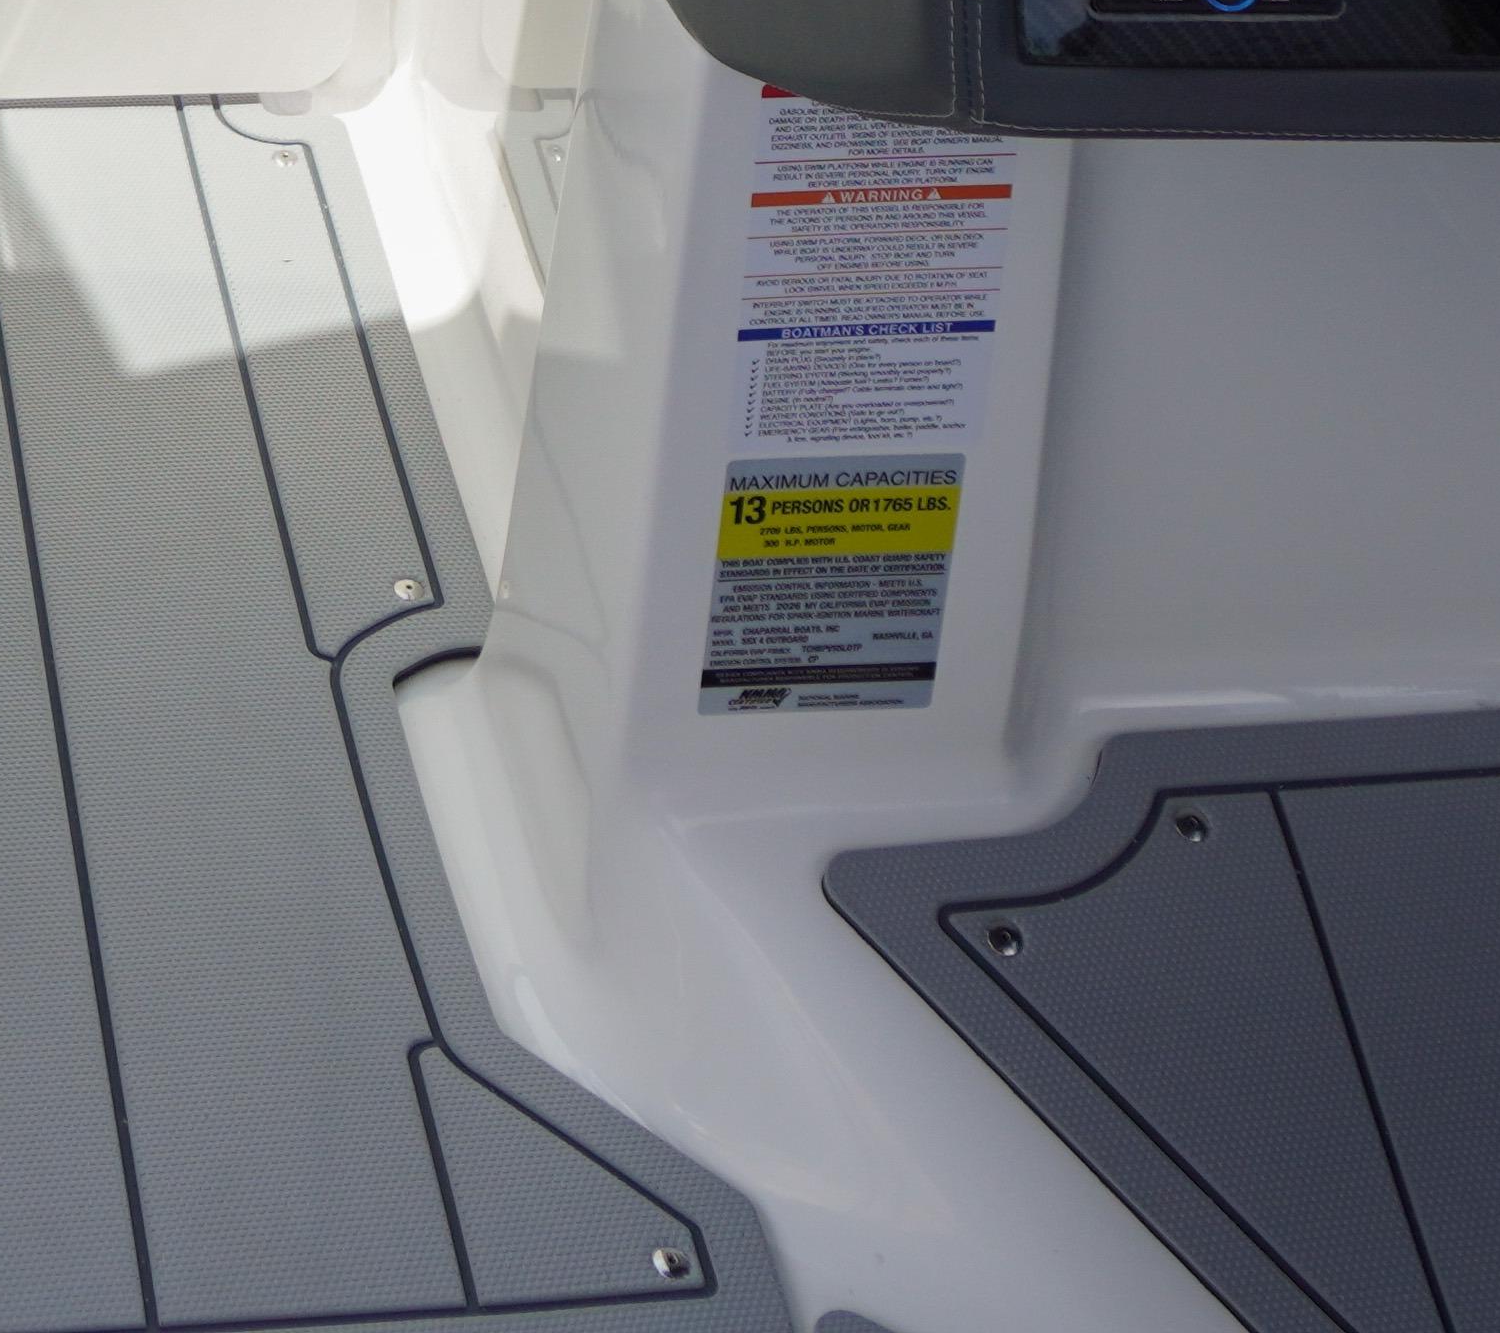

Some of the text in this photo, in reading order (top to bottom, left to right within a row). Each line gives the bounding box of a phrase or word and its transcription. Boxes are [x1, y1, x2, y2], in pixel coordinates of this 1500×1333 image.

[840, 187, 923, 203] WARNING
[781, 321, 953, 339] BOATMAN'S CHECK LIST
[729, 470, 957, 491] MAXIMUM CAPACITIES
[729, 495, 952, 525] 13 PERSONS OR 1765 LBS.
[888, 523, 911, 532] GEAR
[805, 537, 835, 547] MOTOR
[719, 568, 770, 579] STANDARDS
[782, 567, 812, 577] EFFECT
[829, 566, 844, 575] THE
[846, 565, 868, 575] DATE
